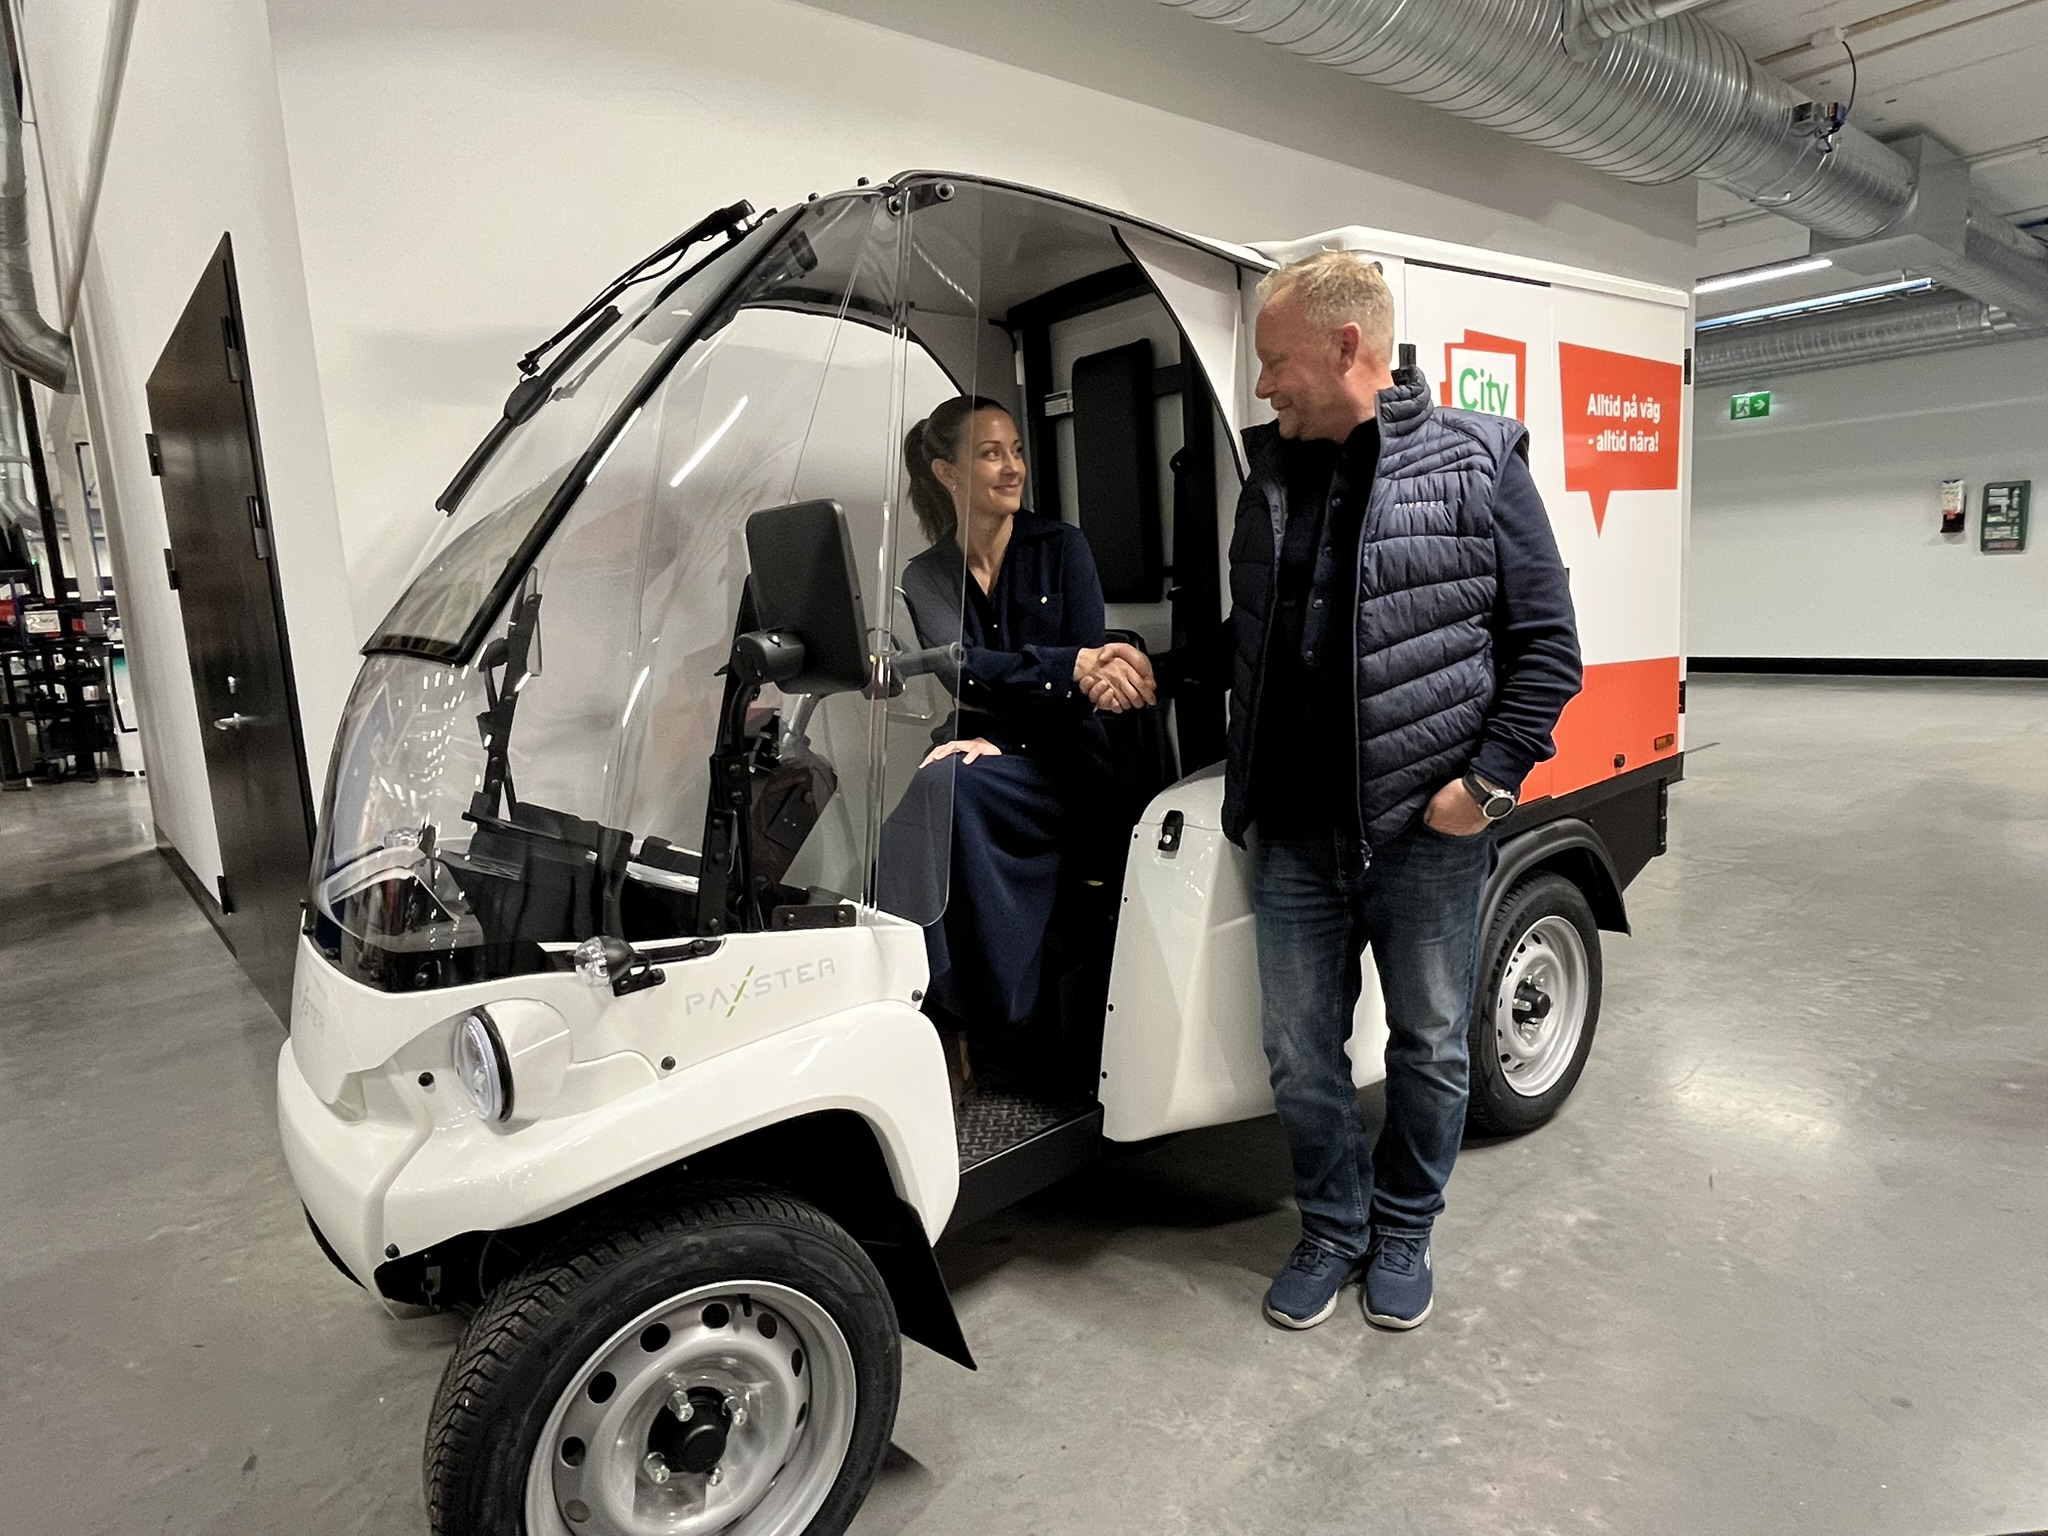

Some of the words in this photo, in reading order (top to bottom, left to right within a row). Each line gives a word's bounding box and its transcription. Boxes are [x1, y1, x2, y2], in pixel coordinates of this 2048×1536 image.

[1459, 367, 1509, 416] City
[1586, 393, 1621, 417] Alltid
[1623, 393, 1638, 422] på
[1639, 397, 1661, 424] väg
[1596, 429, 1627, 452] alltid
[1629, 430, 1659, 452] nära!
[684, 957, 836, 1018] PAXSTER
